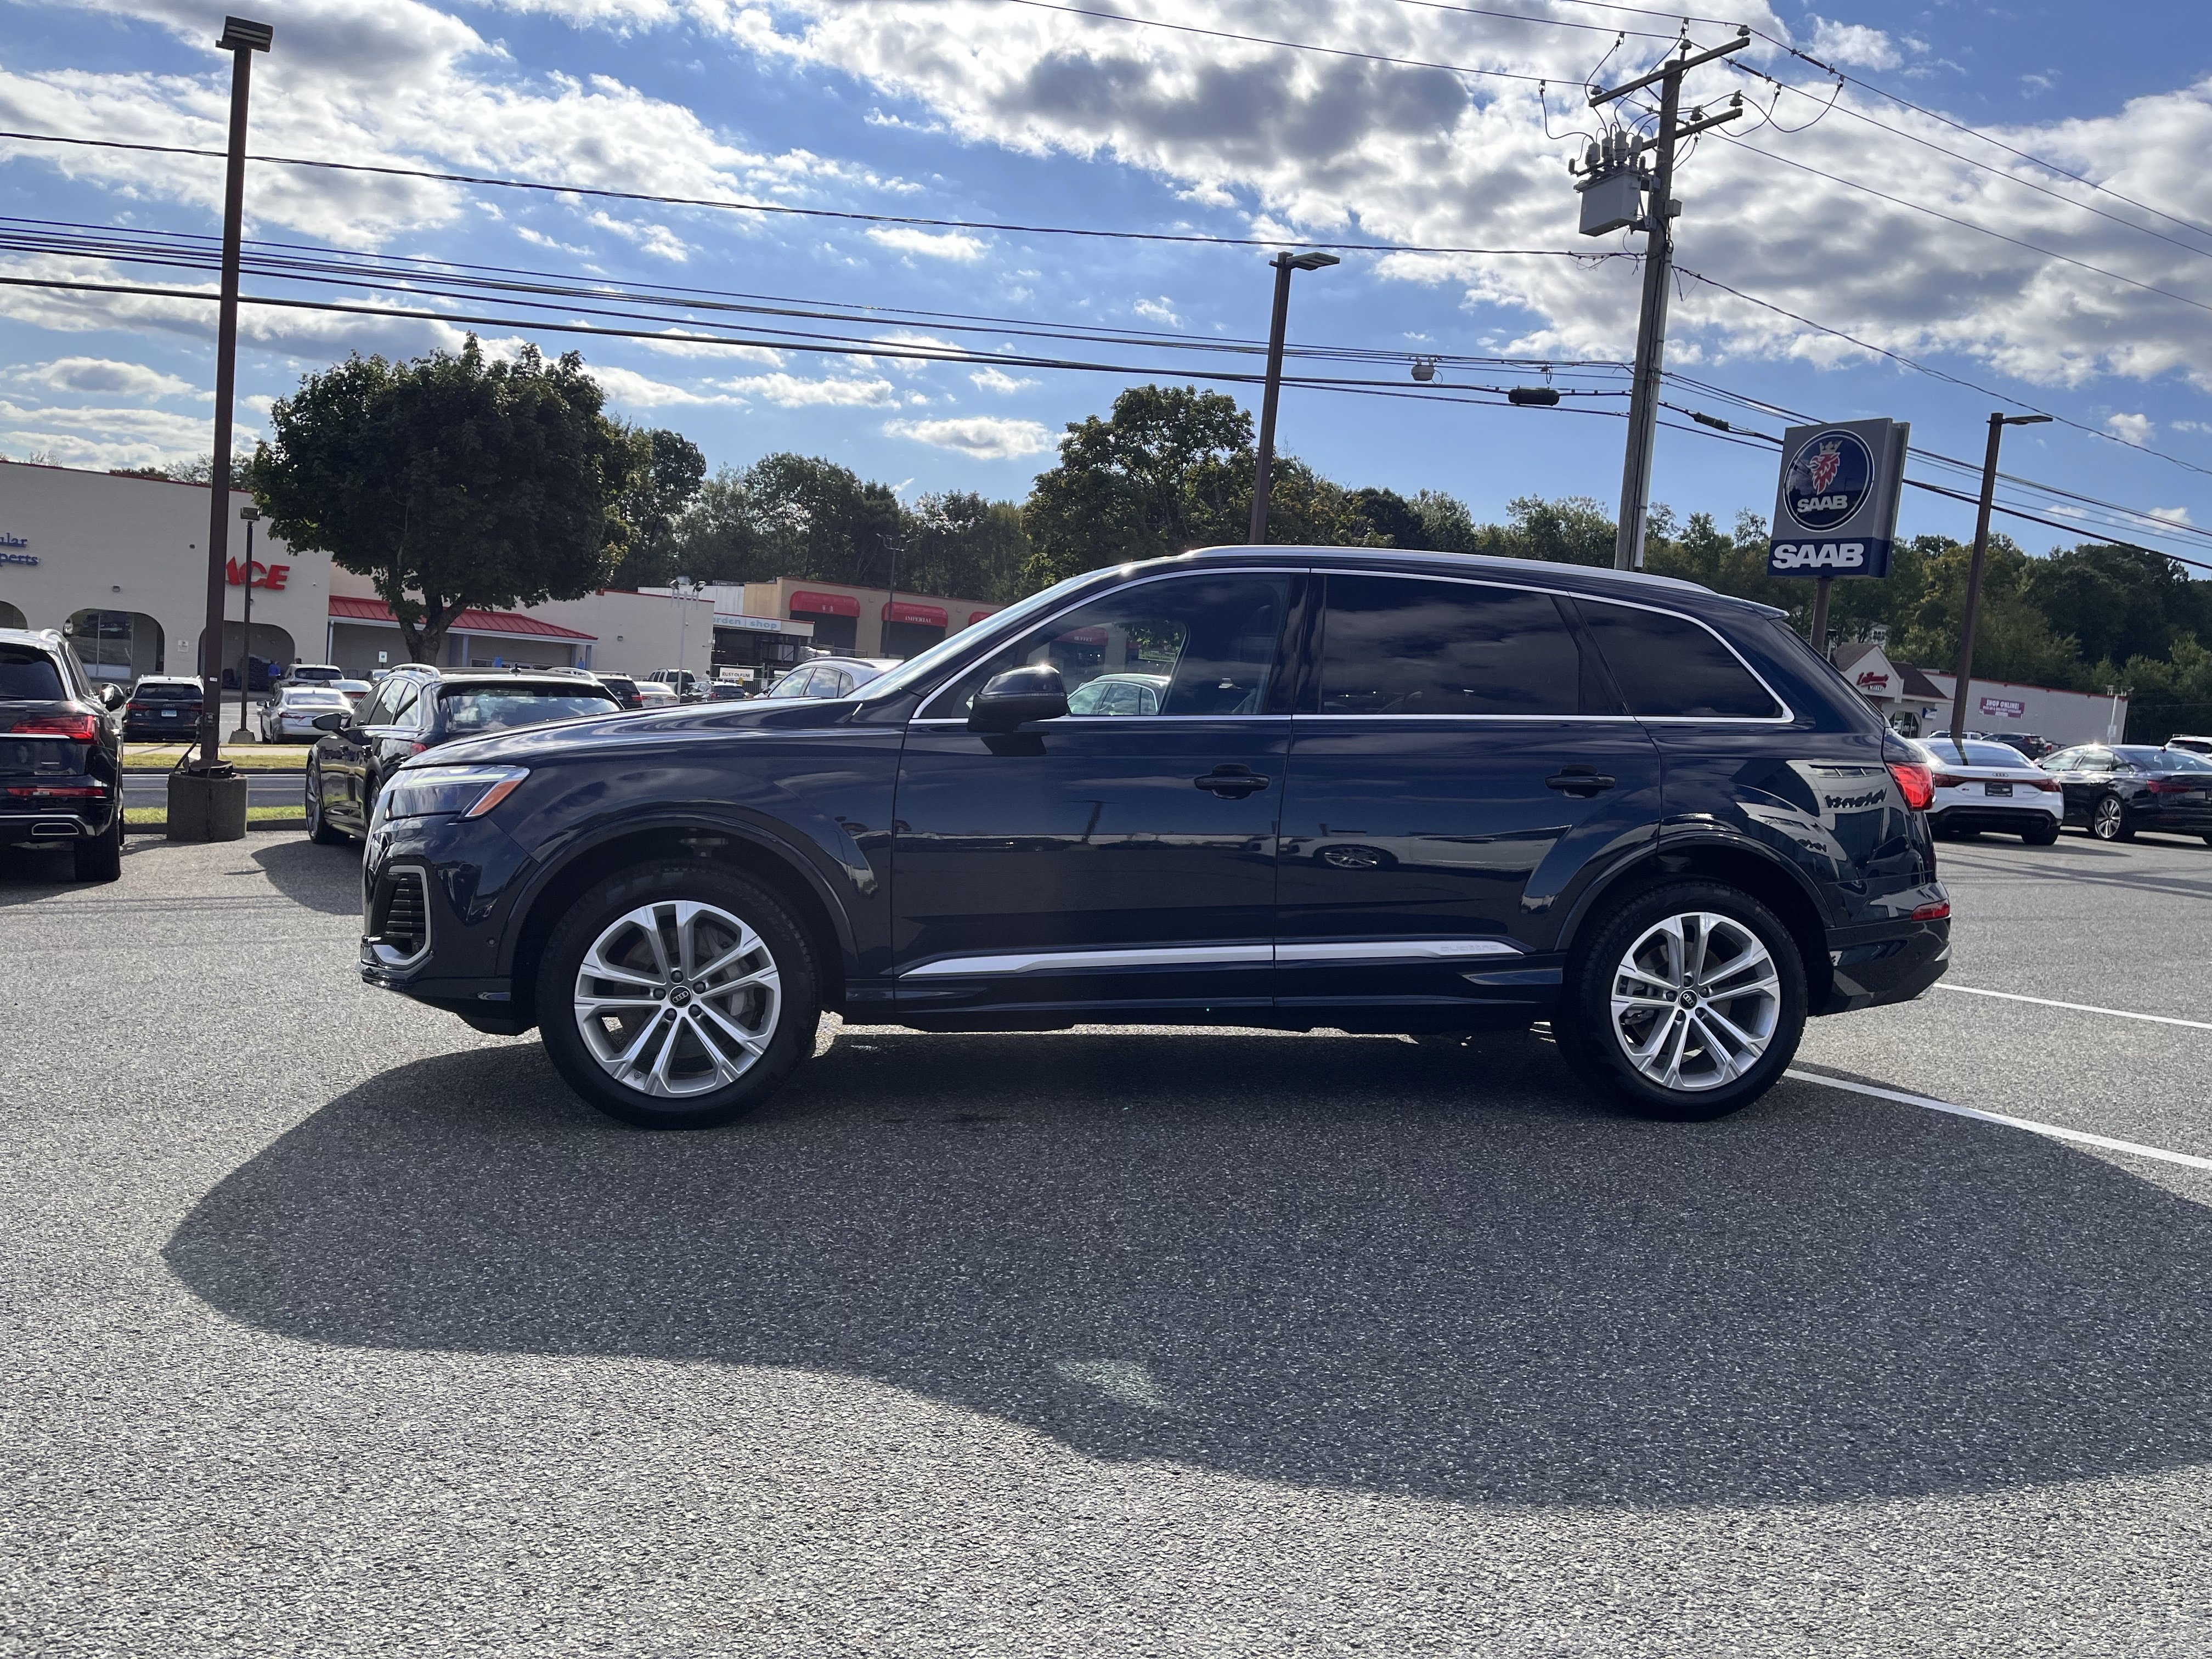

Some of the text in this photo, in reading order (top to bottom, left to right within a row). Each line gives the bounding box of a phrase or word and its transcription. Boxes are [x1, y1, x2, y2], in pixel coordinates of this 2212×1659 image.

[1797, 495, 1848, 513] SAAB
[1772, 543, 1865, 569] SAAB
[713, 616, 777, 630] rden shop
[1440, 944, 1499, 952] quattro
